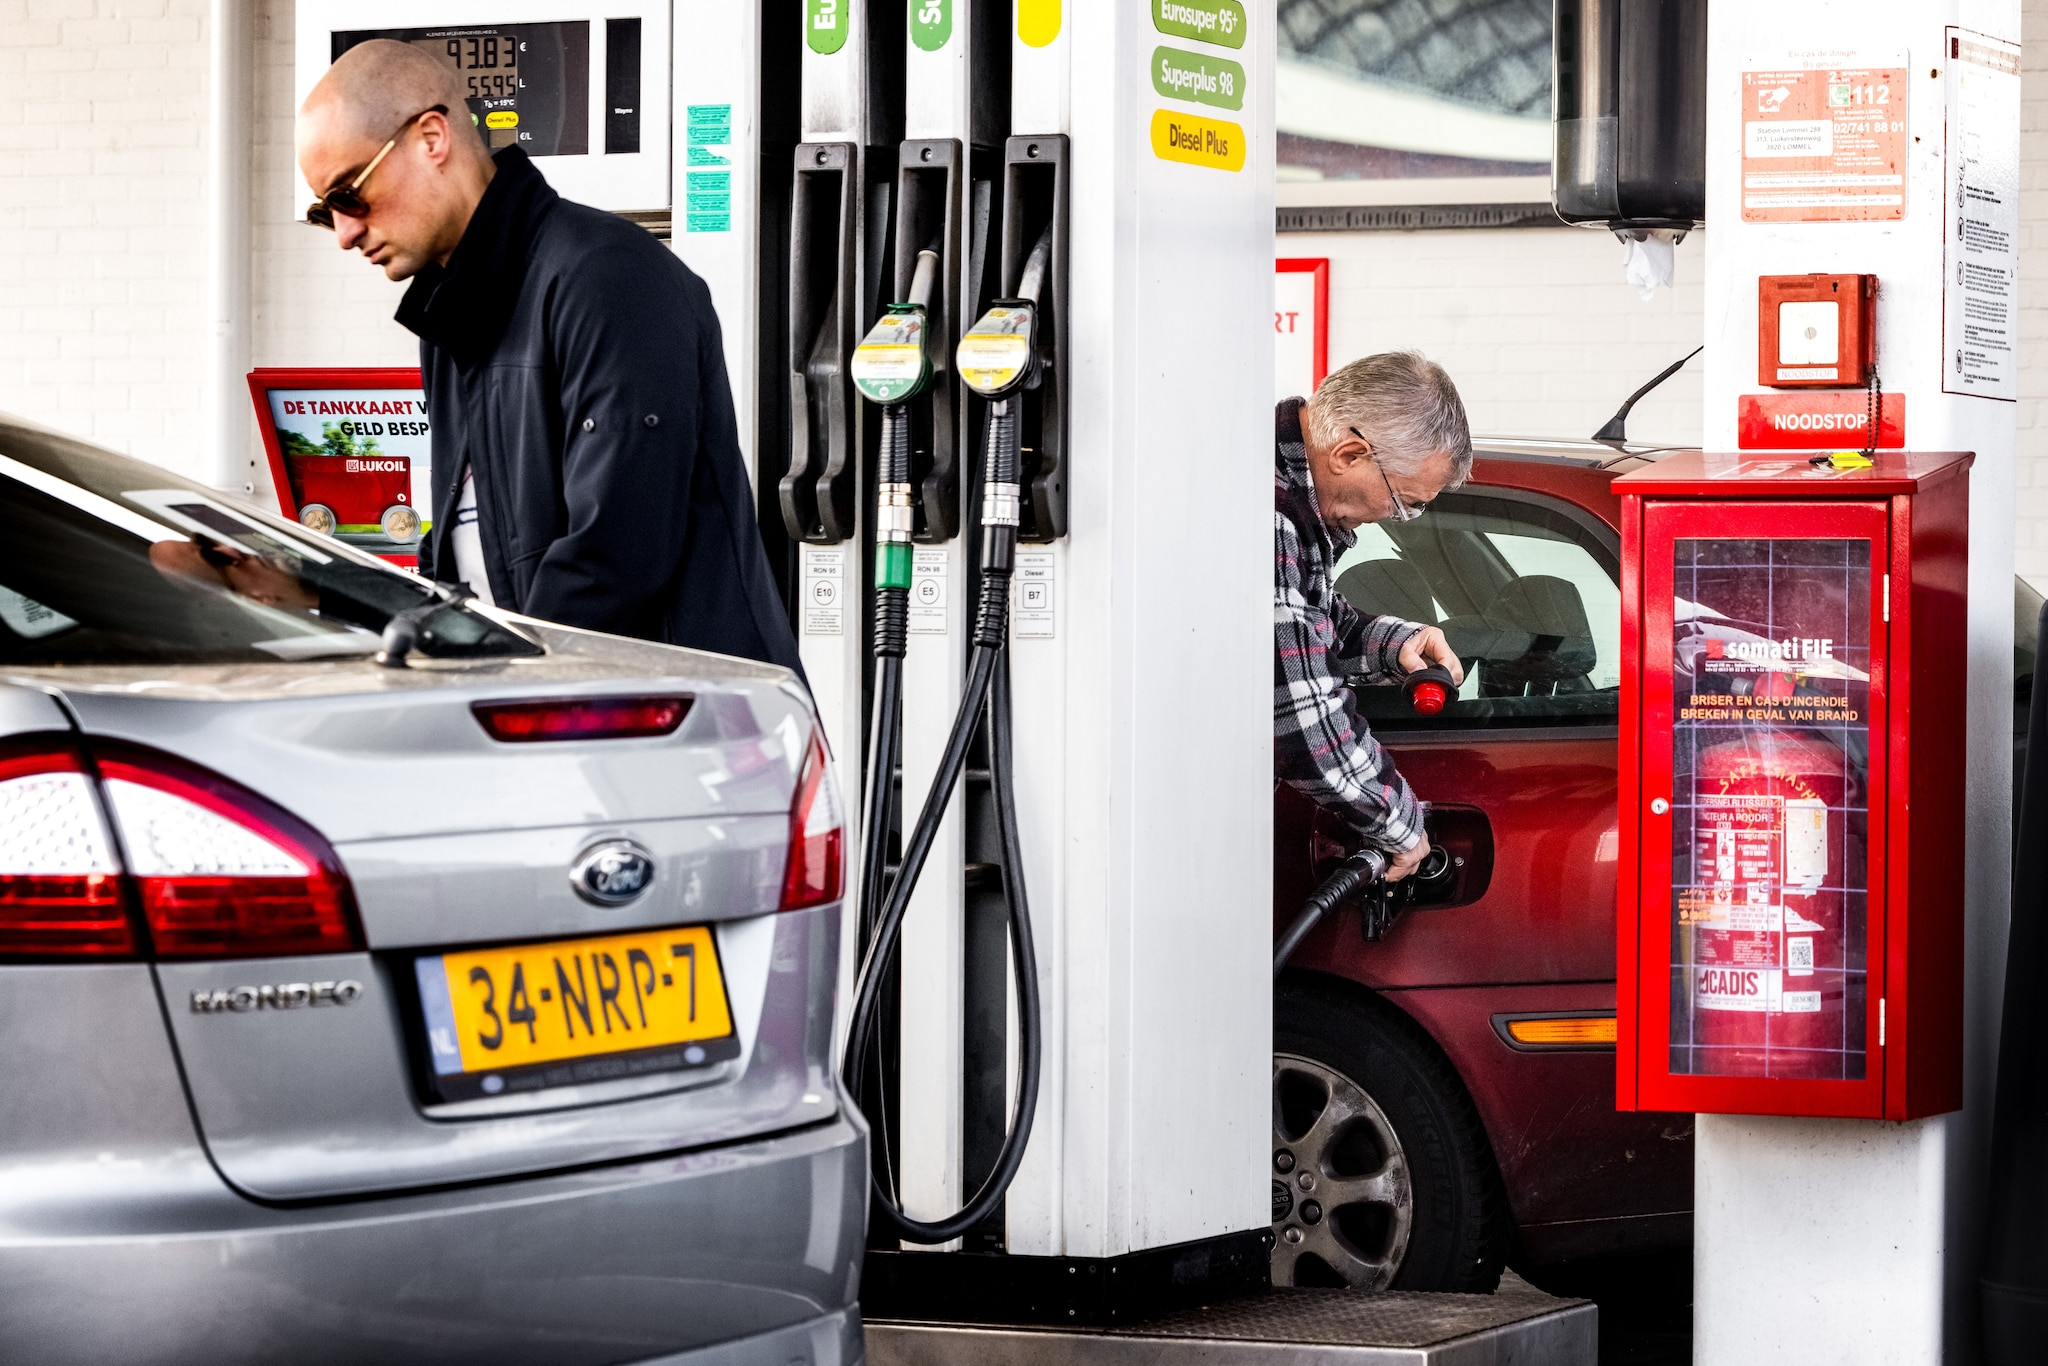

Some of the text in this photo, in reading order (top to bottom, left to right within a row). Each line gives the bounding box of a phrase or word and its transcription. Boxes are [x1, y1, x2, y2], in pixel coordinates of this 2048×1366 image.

[1161, 0, 1238, 34] Eurosuper 95+
[447, 37, 516, 69] 93.83
[519, 78, 526, 88] L
[1161, 59, 1234, 97] Superplus 98
[1852, 84, 1890, 105] 112
[1833, 121, 1905, 133] 02/741 88 01
[1169, 123, 1228, 157] Diesel Plus
[1781, 369, 1833, 378] NOODSTOP
[283, 401, 307, 415] DE
[307, 401, 413, 415] TANKKAART
[1774, 413, 1869, 430] NOODSTOP
[340, 422, 429, 436] GELD BESP
[359, 460, 407, 472] LUKOIL
[816, 588, 832, 597] E10
[922, 587, 934, 596] E5
[1028, 591, 1040, 600] B7
[1727, 636, 1834, 660] somati FIE
[1689, 694, 1849, 708] BRISER EN CAS D'INCENDIE
[1680, 709, 1858, 721] BREKEN IN GEVAL VAN BRAND
[597, 853, 645, 893] Ford
[190, 979, 364, 1015] MONDEO
[469, 942, 696, 1051] 34-NRP-7
